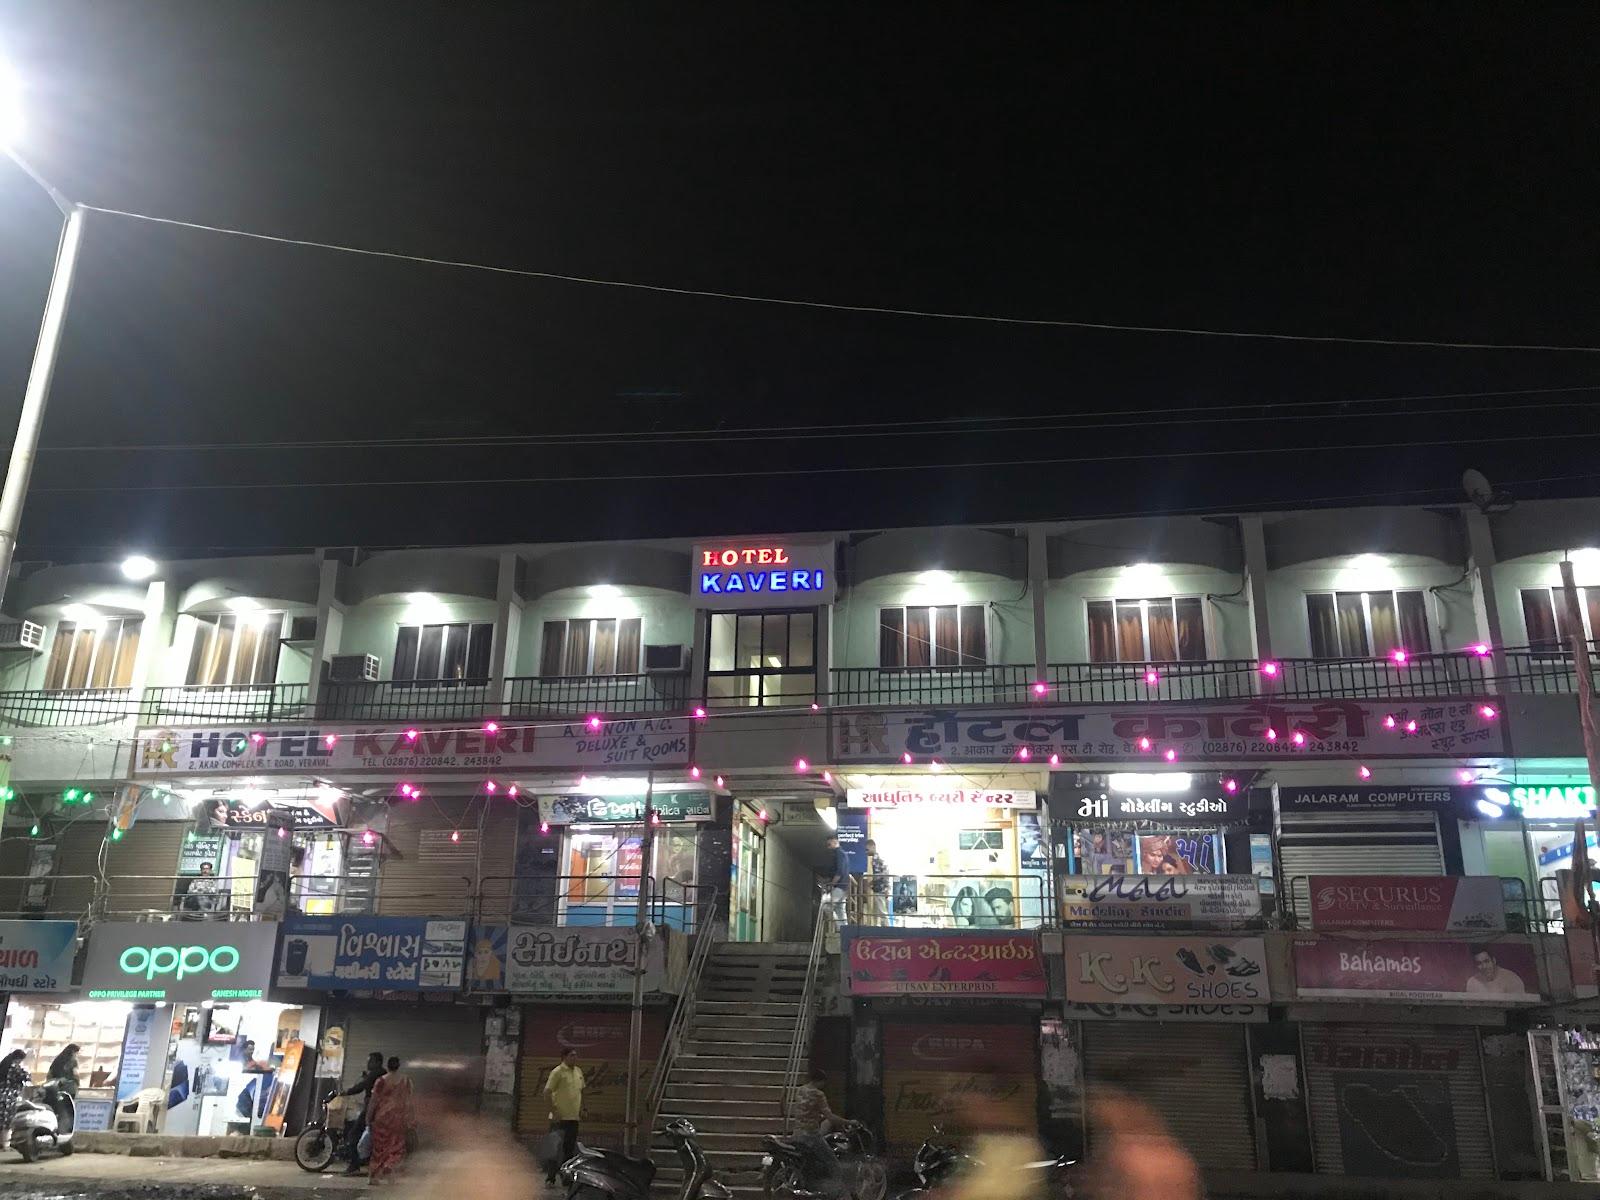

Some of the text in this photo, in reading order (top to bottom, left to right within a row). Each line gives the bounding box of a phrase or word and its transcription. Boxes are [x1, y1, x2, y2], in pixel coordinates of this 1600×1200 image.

[703, 548, 788, 566] HOTEL
[701, 569, 823, 592] KAVERI
[190, 724, 537, 758] HOTEL KAVERI
[904, 711, 1085, 754] होटल
[576, 736, 628, 753] DELUXE
[1309, 741, 1358, 752] 243842
[1295, 792, 1451, 803] JALARAM COMPUTERS
[1337, 887, 1441, 902] SECURUS
[1339, 950, 1422, 974] Bahamas
[89, 990, 106, 998] OPPO
[1186, 981, 1259, 999] SHOES
